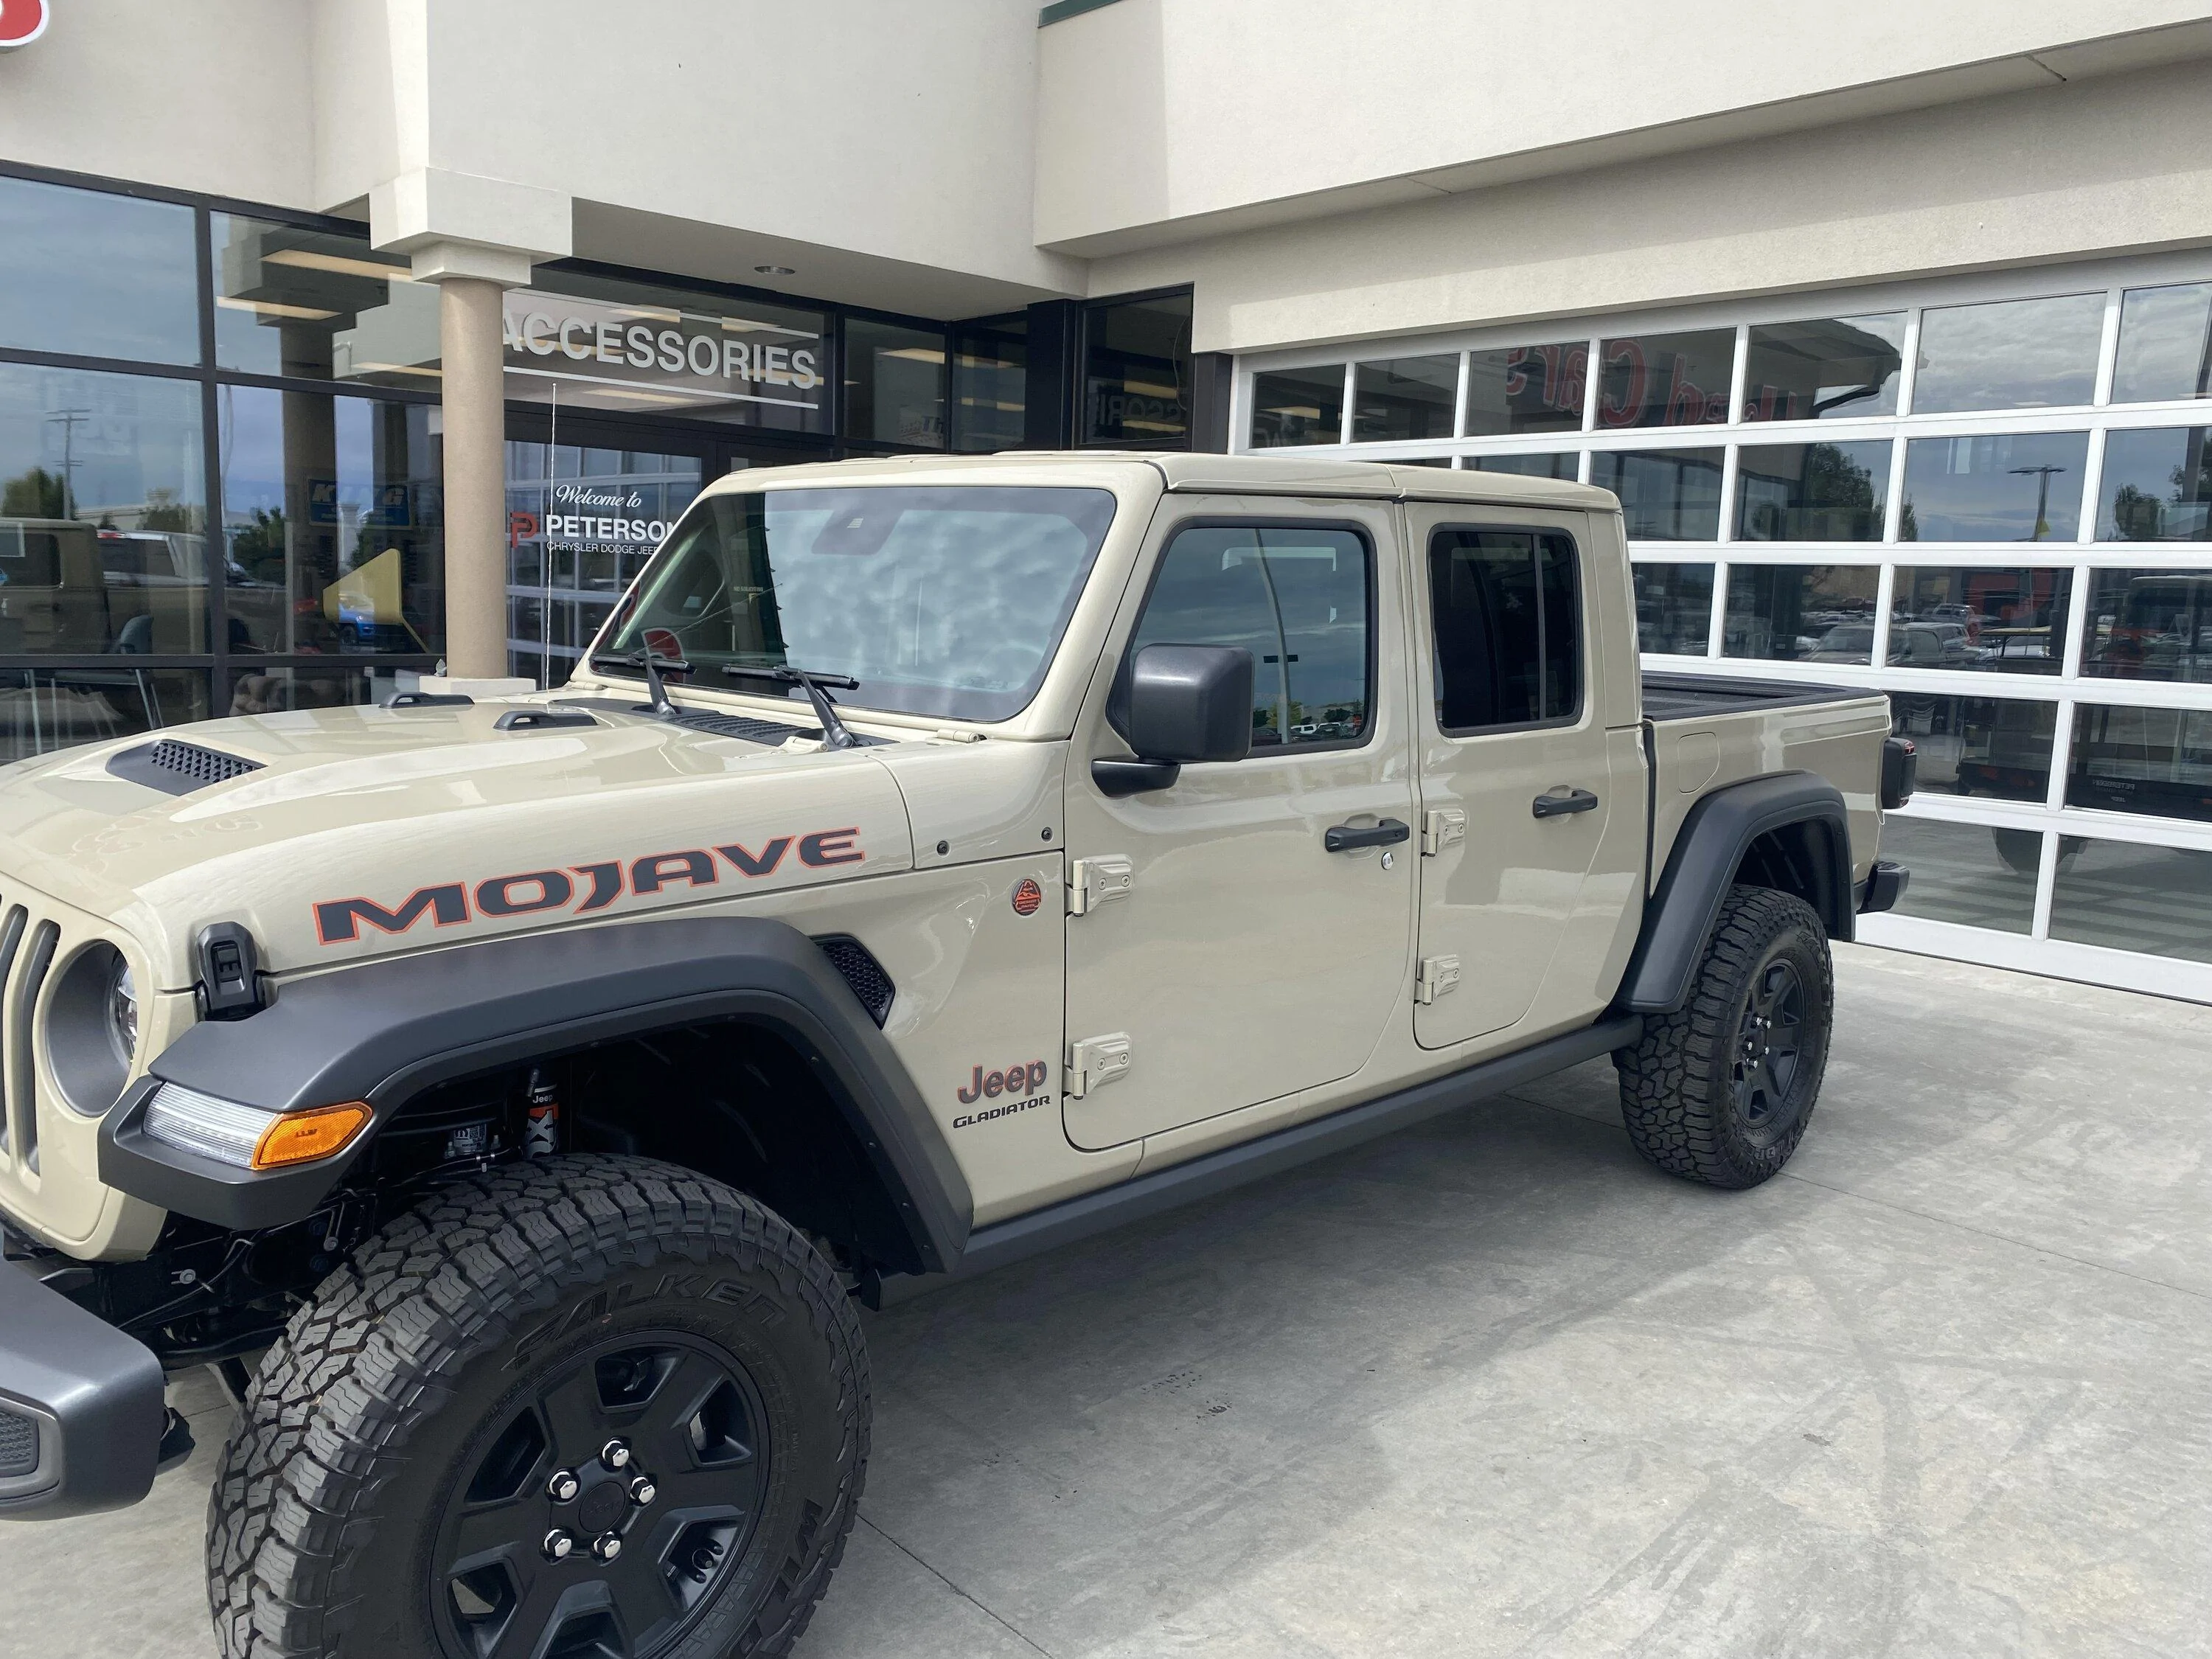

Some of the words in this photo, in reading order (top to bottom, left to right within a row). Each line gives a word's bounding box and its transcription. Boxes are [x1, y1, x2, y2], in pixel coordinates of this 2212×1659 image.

[503, 307, 816, 389] ACCESSORIES
[555, 484, 624, 508] Welcome
[626, 491, 642, 508] to
[547, 541, 598, 553] CHRYSLER
[600, 543, 635, 554] DODGE
[313, 826, 866, 946] MOJAVE
[532, 1094, 554, 1104] Jeep
[957, 1060, 1048, 1104] Jeep
[953, 1095, 1051, 1129] GLADIATOR
[500, 1272, 787, 1370] FALKEN
